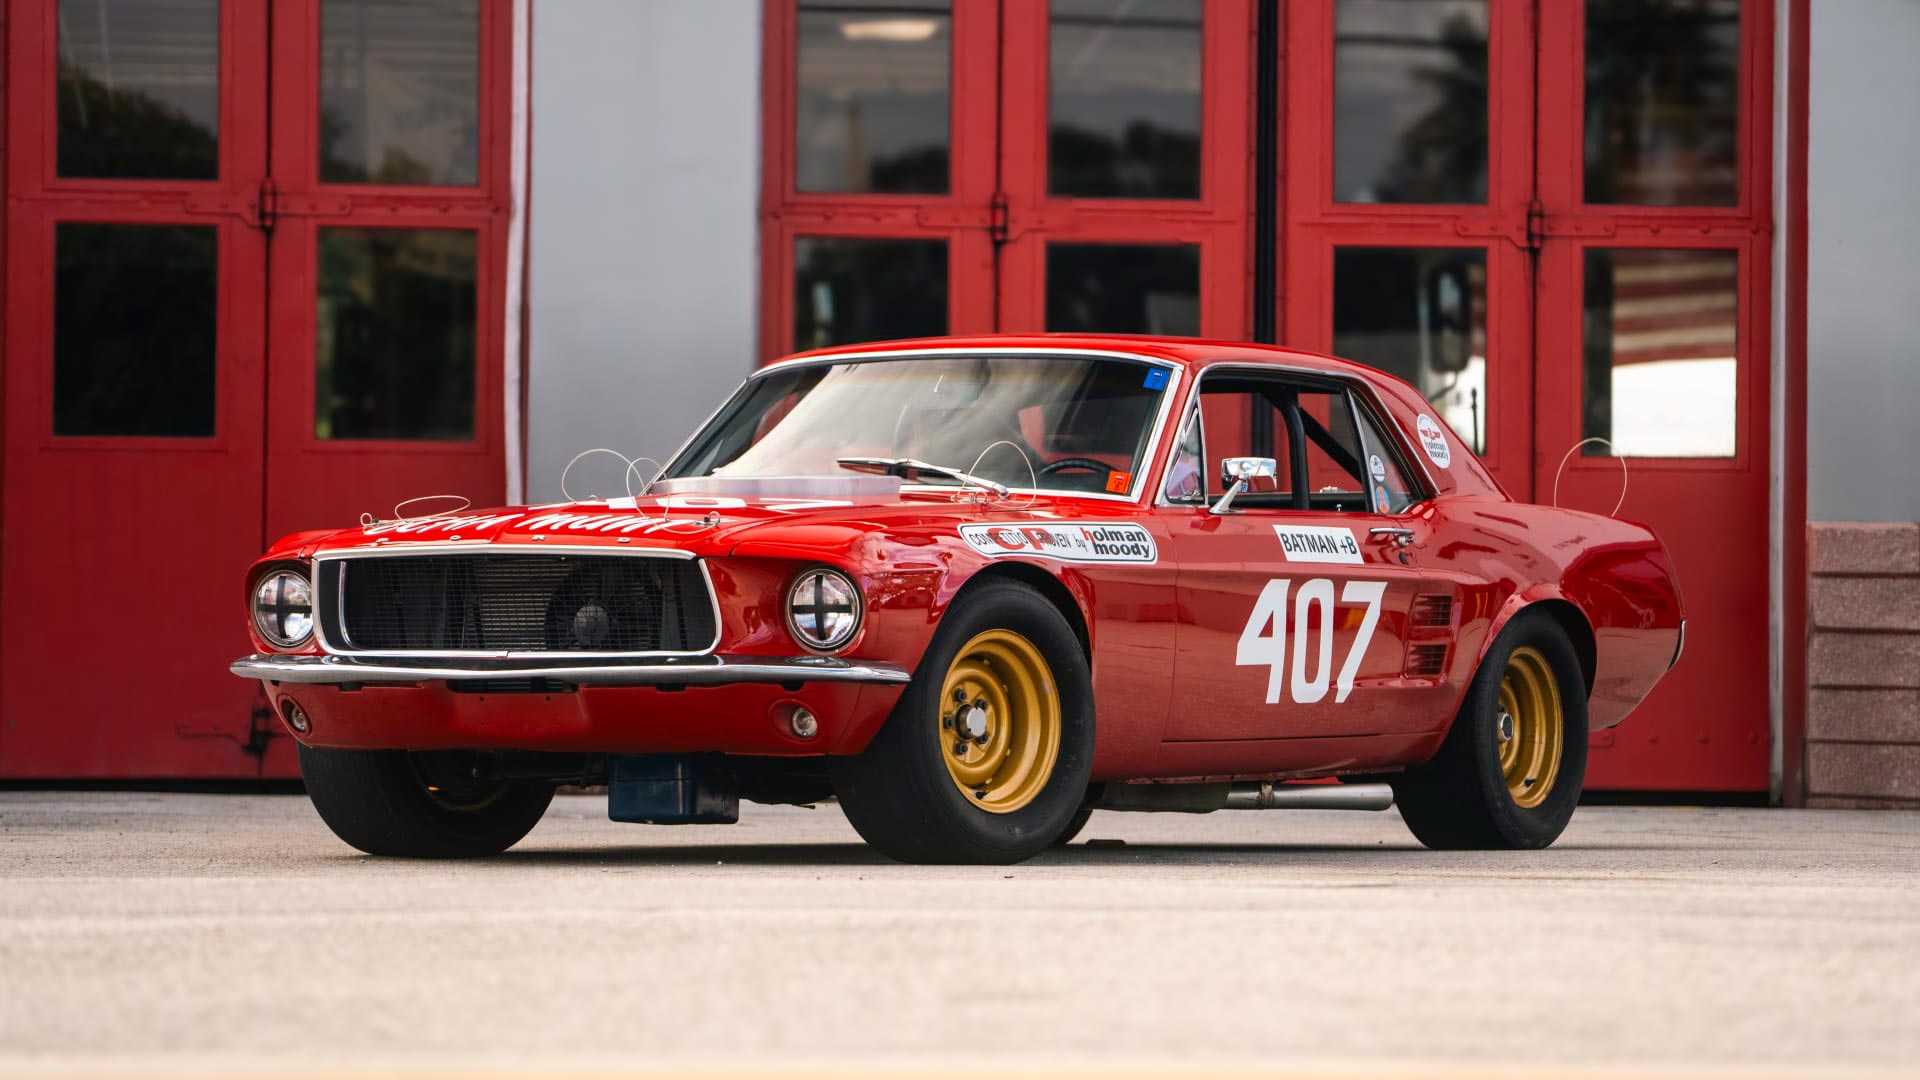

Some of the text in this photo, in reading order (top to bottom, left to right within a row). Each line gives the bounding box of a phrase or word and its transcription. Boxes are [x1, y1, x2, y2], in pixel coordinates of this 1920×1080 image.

[1079, 527, 1147, 543] holman
[1280, 533, 1357, 555] BATMAN +B
[1093, 543, 1150, 558] moody
[1235, 578, 1388, 704] 407
